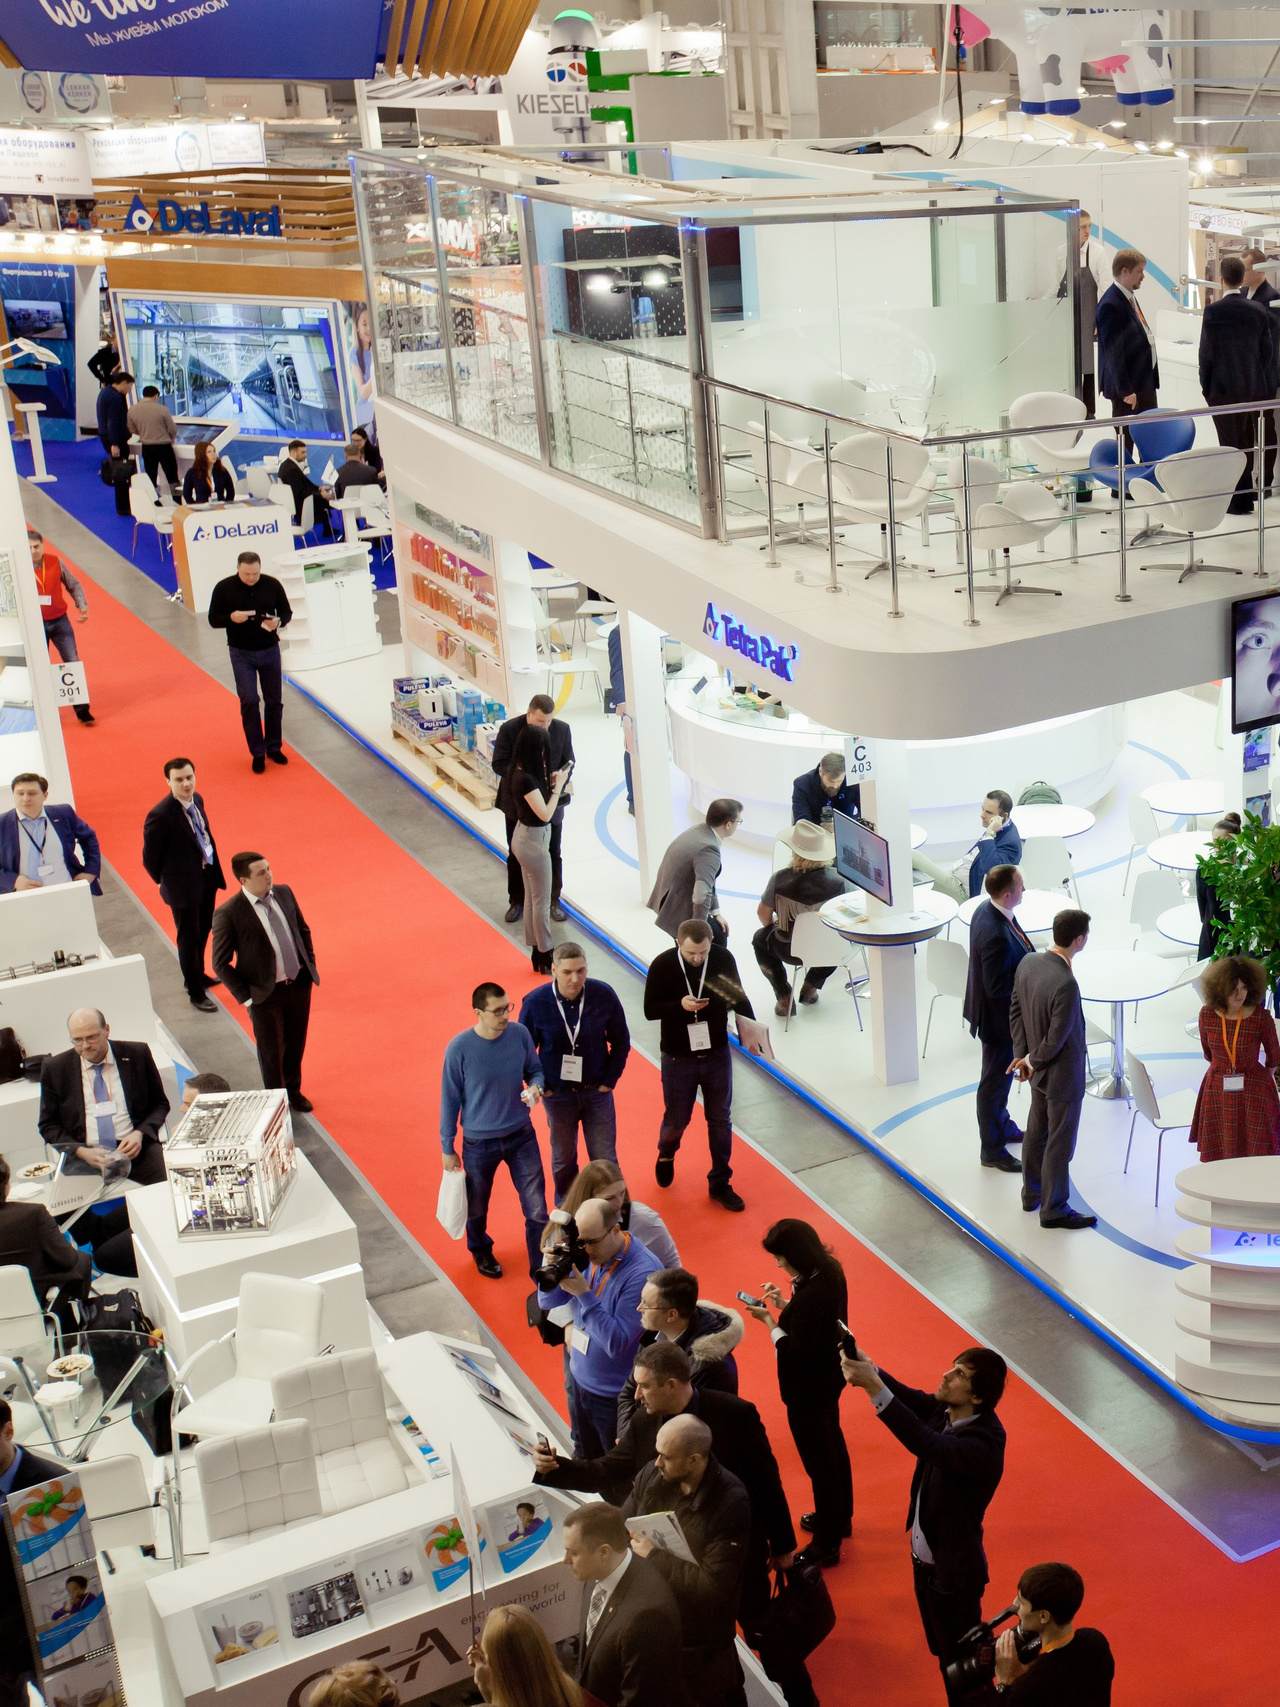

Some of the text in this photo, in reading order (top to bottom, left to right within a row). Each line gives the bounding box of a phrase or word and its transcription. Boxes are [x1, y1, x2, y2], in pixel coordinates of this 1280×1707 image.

[85, 0, 230, 48] Мы живём молоком
[11, 137, 77, 149] оборудования
[157, 200, 282, 237] DeLaval
[213, 520, 280, 540] DeLaval
[61, 672, 76, 687] C
[59, 687, 81, 698] 301
[403, 683, 426, 692] PULEVA
[423, 719, 449, 729] PULEVA
[854, 745, 867, 761] C
[851, 761, 872, 775] 403
[249, 1593, 263, 1601] GEA
[461, 1581, 561, 1626] engiering for
[529, 1591, 566, 1613] world
